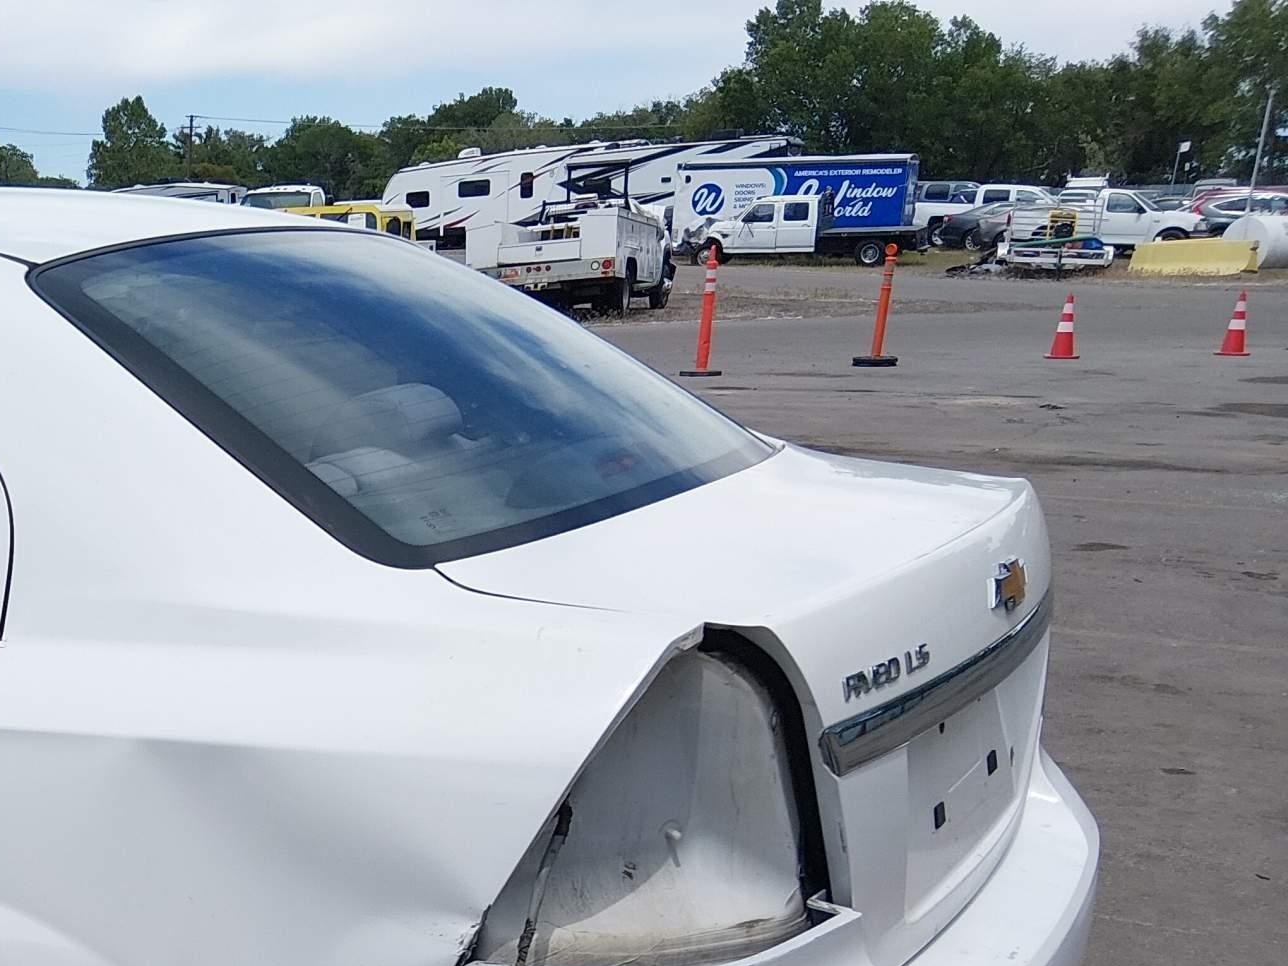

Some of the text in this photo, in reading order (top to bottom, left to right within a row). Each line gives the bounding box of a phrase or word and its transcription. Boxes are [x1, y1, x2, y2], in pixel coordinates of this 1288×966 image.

[829, 168, 861, 176] EXTERIOR
[862, 167, 903, 176] REMODELER
[841, 643, 931, 704] AVEO LS
